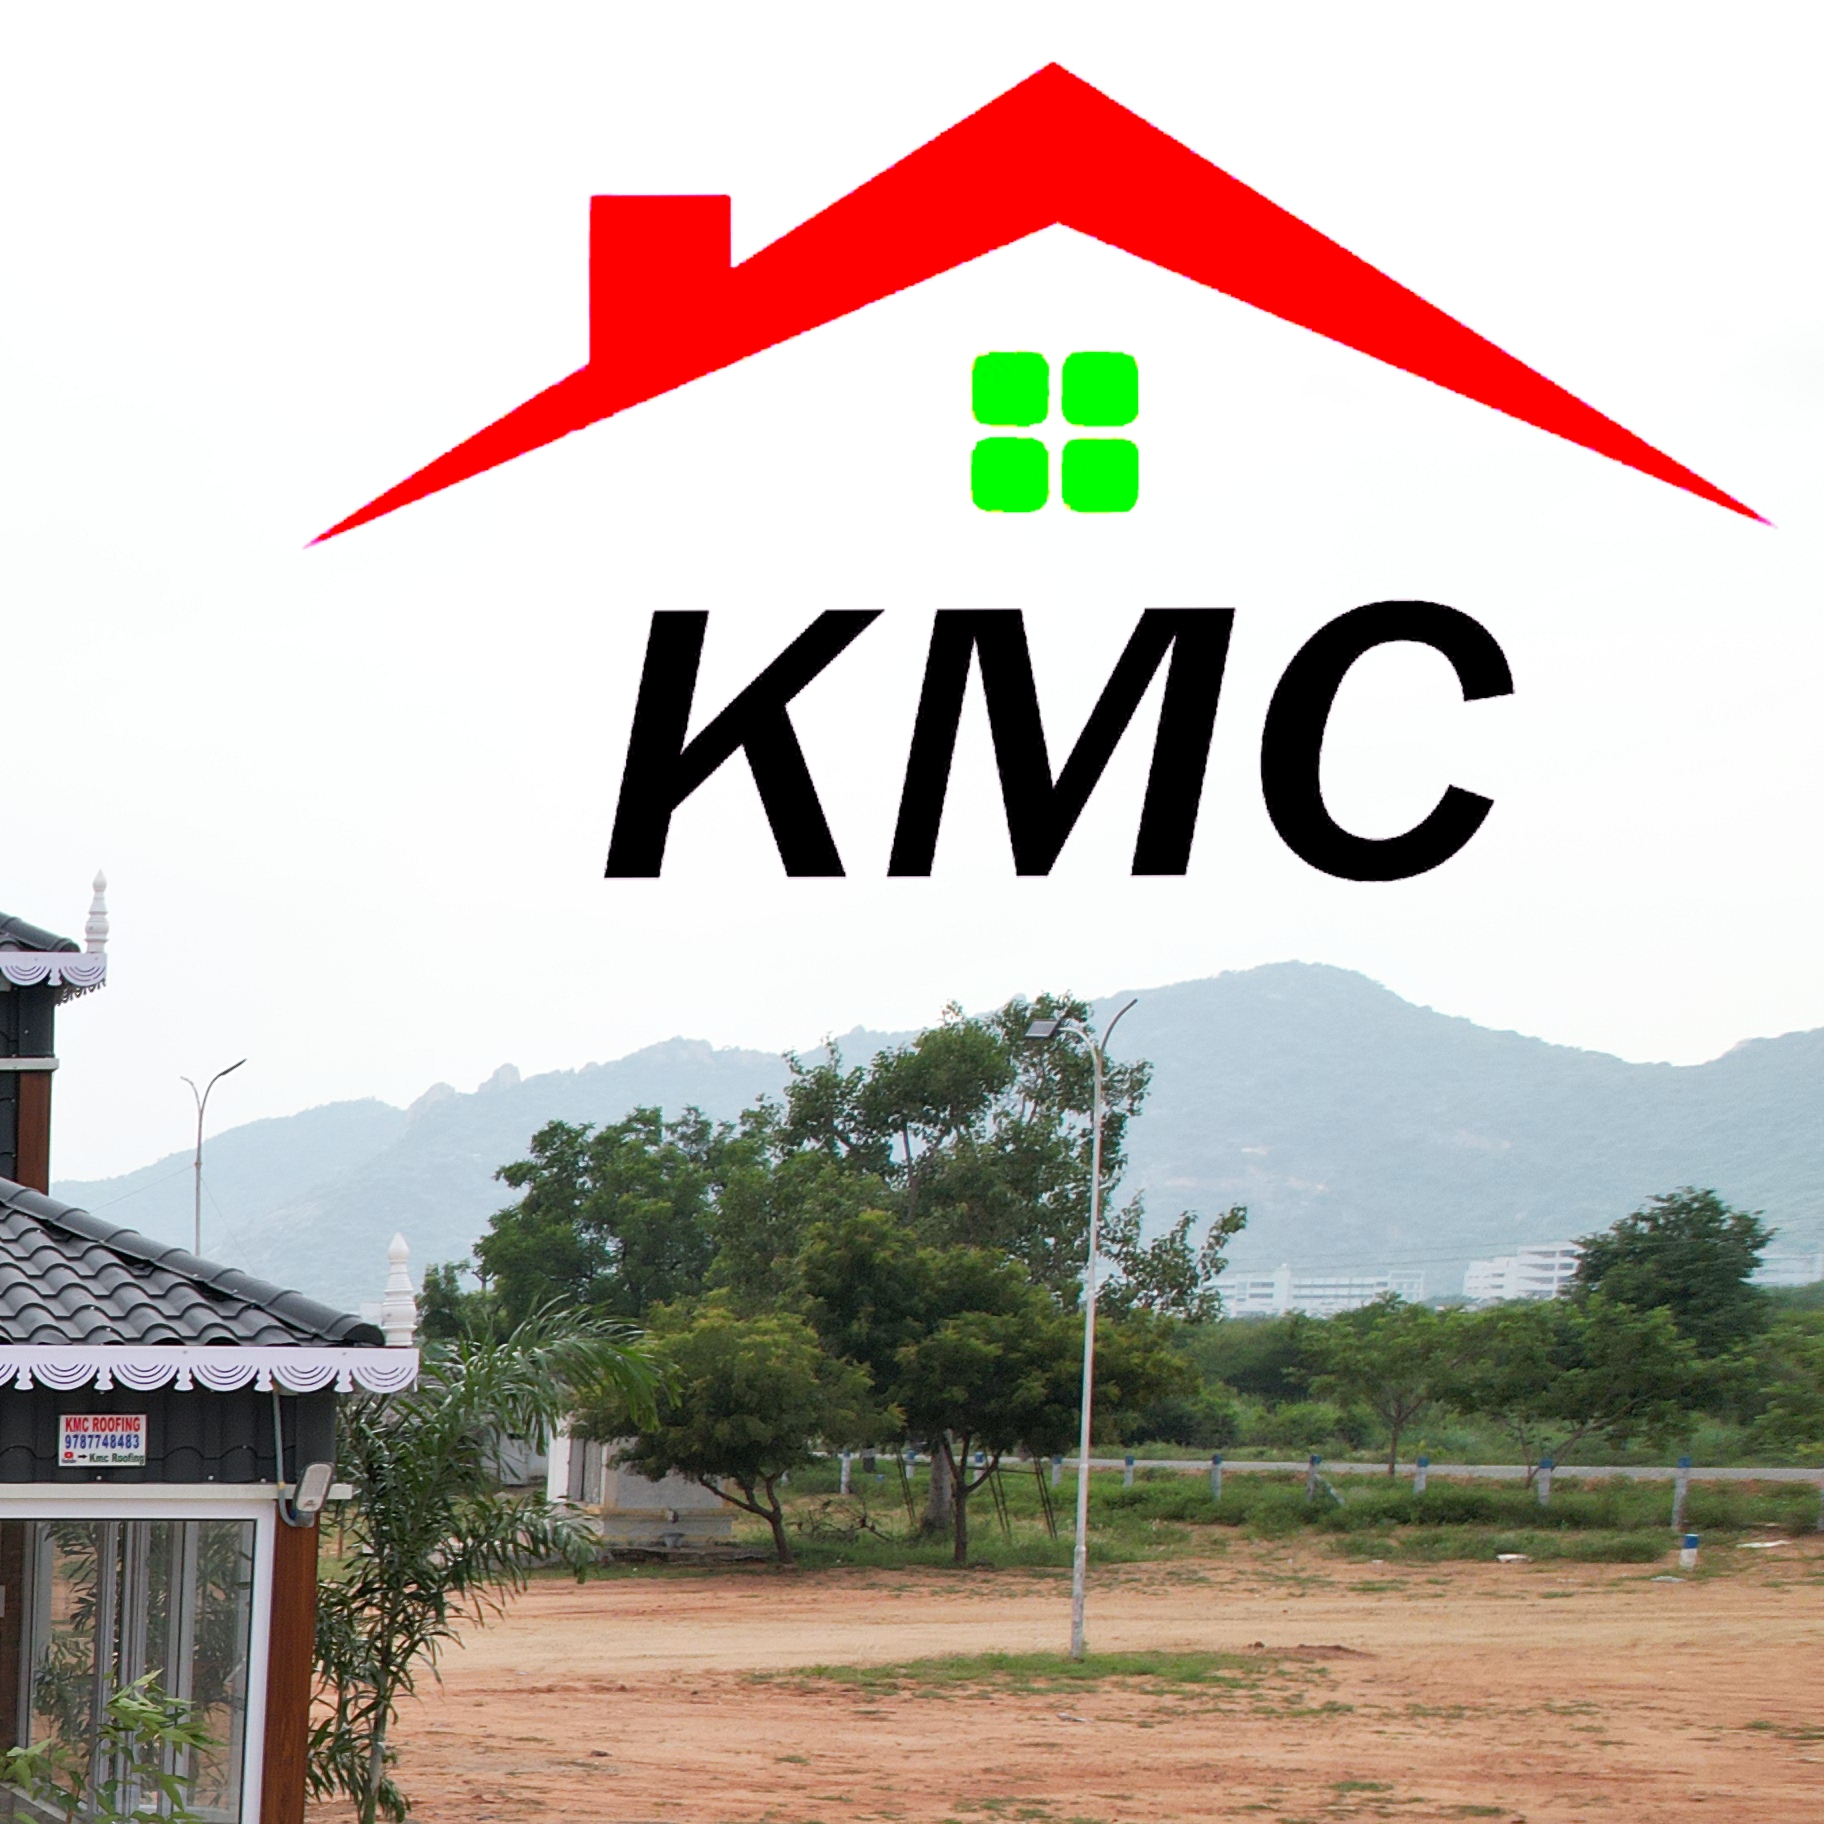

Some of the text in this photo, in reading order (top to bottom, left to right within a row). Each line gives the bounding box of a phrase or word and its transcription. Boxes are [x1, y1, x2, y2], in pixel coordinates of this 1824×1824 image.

[65, 1417, 140, 1432] KMC ROOFING
[65, 1434, 140, 1449] 9787748483
[112, 1453, 145, 1465] Roofing
